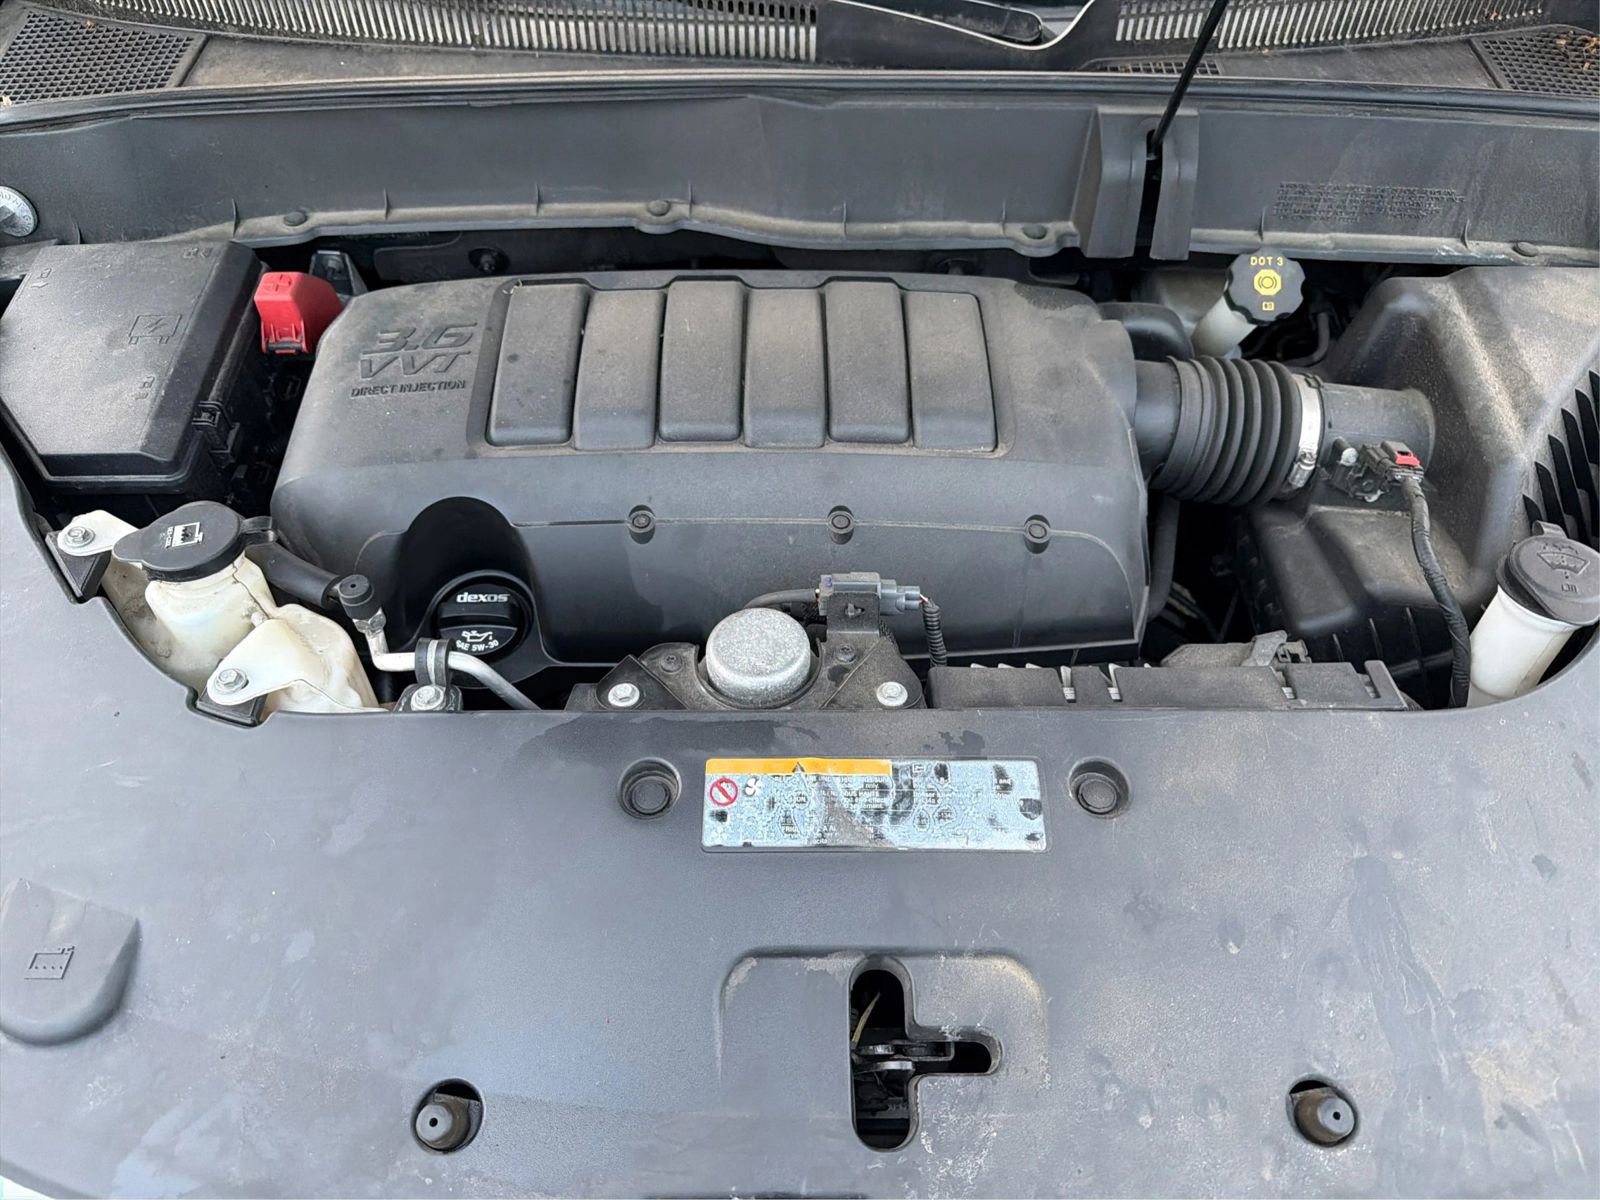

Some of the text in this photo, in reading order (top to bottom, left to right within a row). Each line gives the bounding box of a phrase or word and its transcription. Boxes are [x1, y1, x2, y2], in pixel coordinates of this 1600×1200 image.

[1250, 256, 1284, 266] DOT 3
[362, 322, 478, 355] 3.6
[360, 351, 471, 379] VVT
[351, 380, 466, 398] DIRECT INJECTION
[456, 592, 511, 603] dexos
[455, 639, 499, 652] SAE 5W-30
